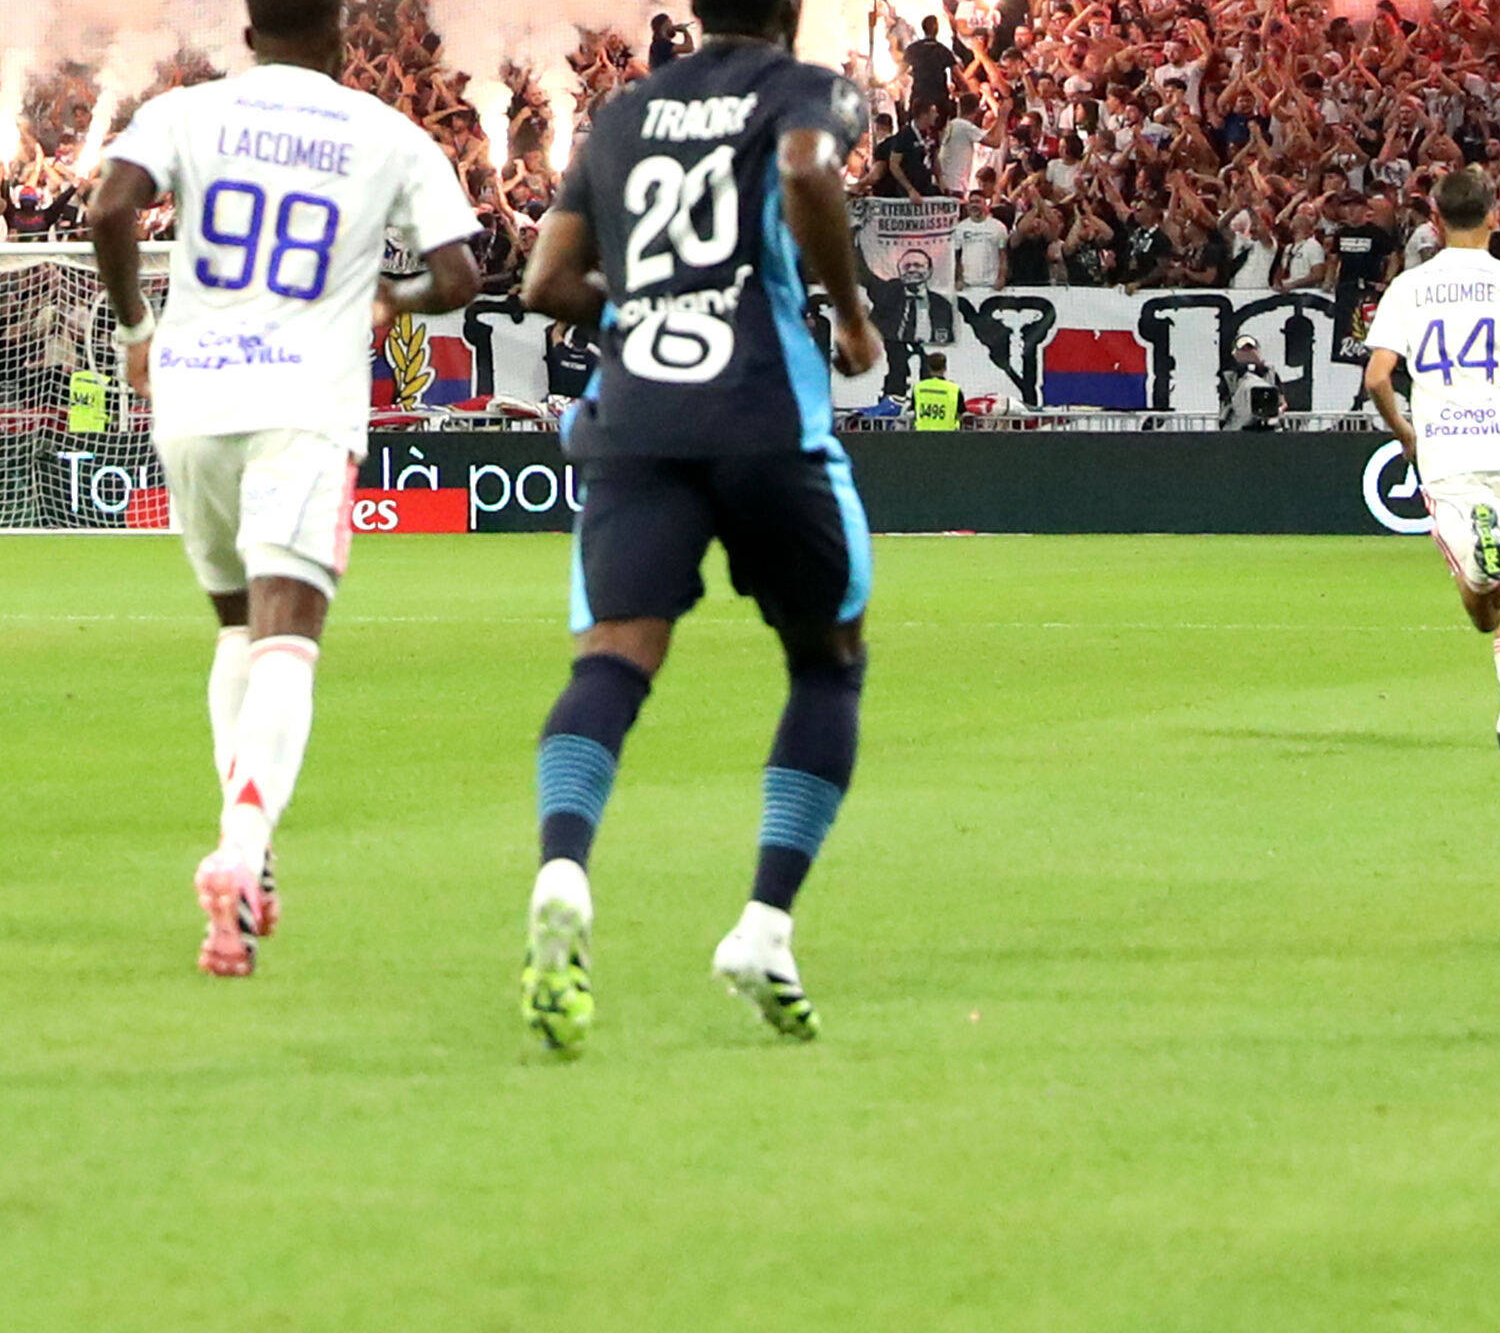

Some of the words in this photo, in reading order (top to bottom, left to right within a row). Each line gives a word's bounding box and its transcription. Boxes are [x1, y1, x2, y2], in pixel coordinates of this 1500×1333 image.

[217, 124, 354, 177] LACOMBE
[195, 179, 340, 301] 98
[624, 145, 739, 292] 20
[1415, 282, 1496, 308] LACOMBE
[1415, 317, 1499, 386] 44
[1440, 407, 1497, 425] Congo
